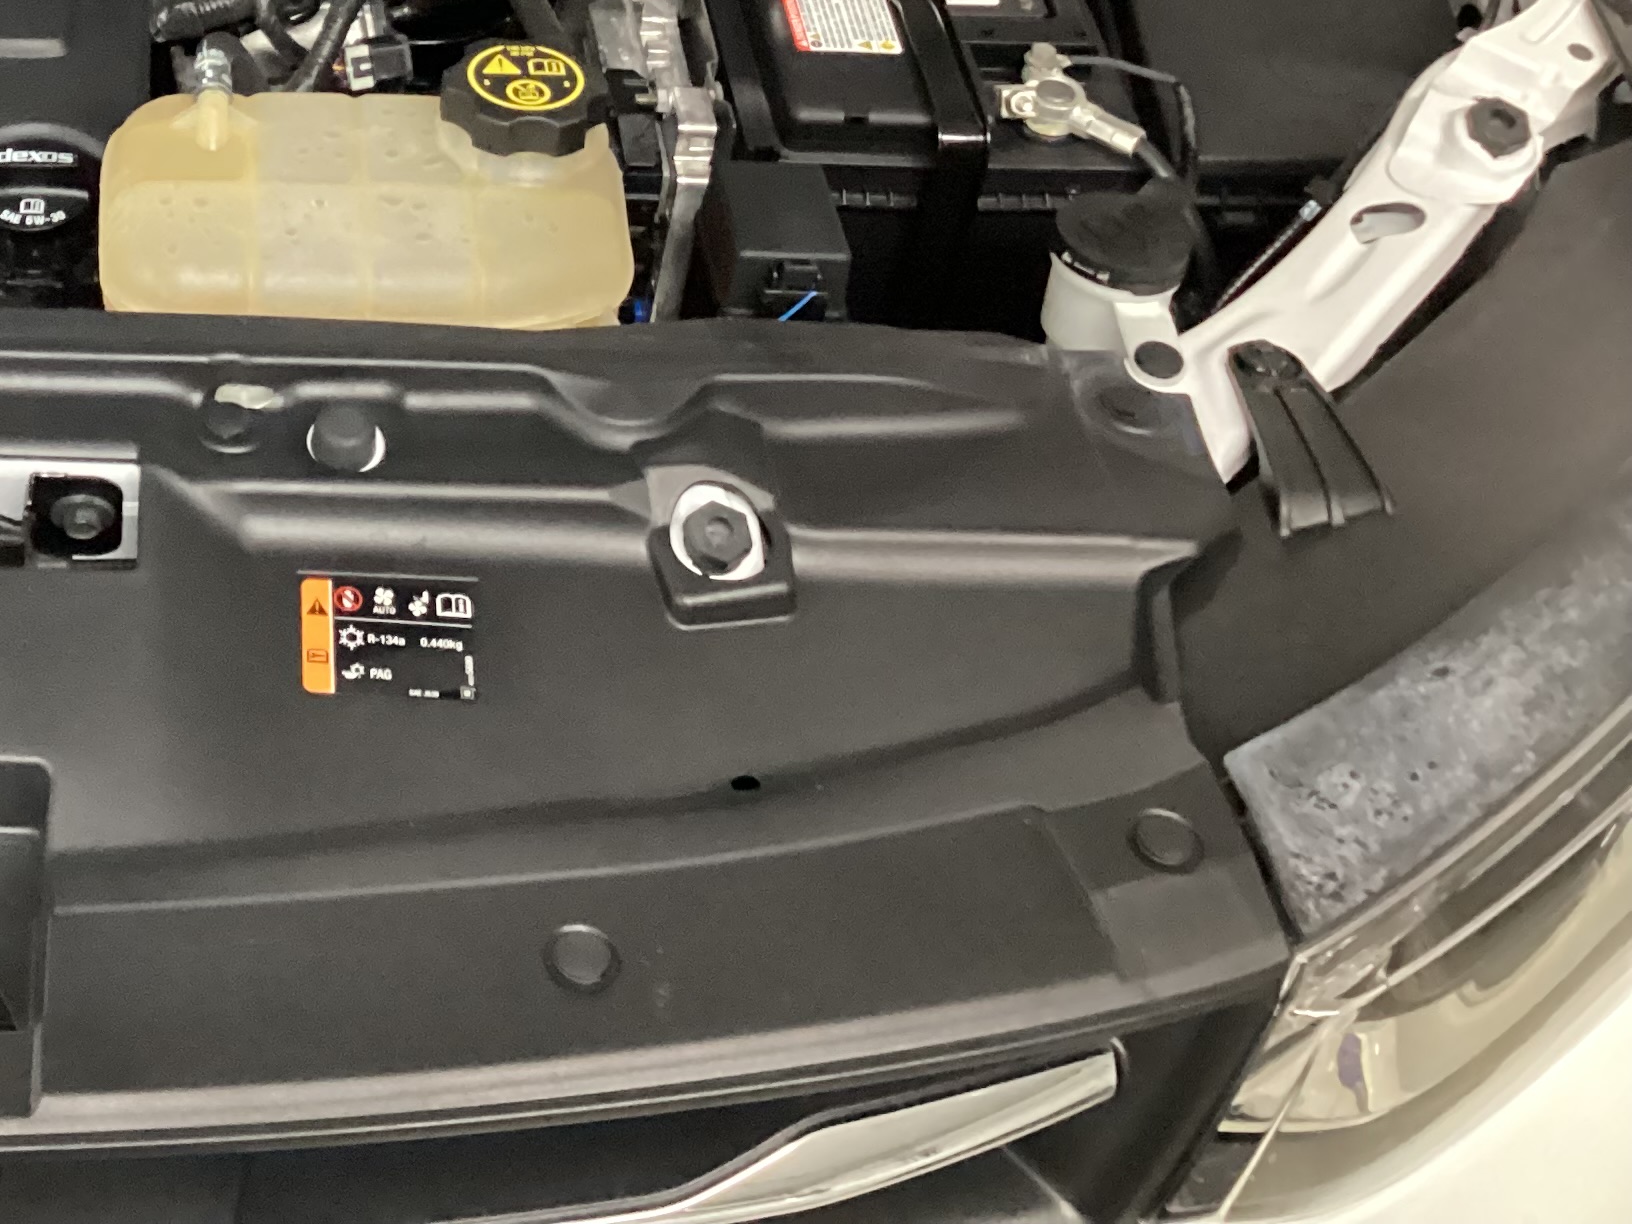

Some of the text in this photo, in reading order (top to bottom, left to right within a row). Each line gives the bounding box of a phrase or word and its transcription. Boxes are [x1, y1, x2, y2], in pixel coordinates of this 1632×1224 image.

[0, 208, 22, 225] SAE
[372, 605, 397, 616] AUTO
[367, 633, 406, 646] R-134a
[369, 667, 392, 680] PAG
